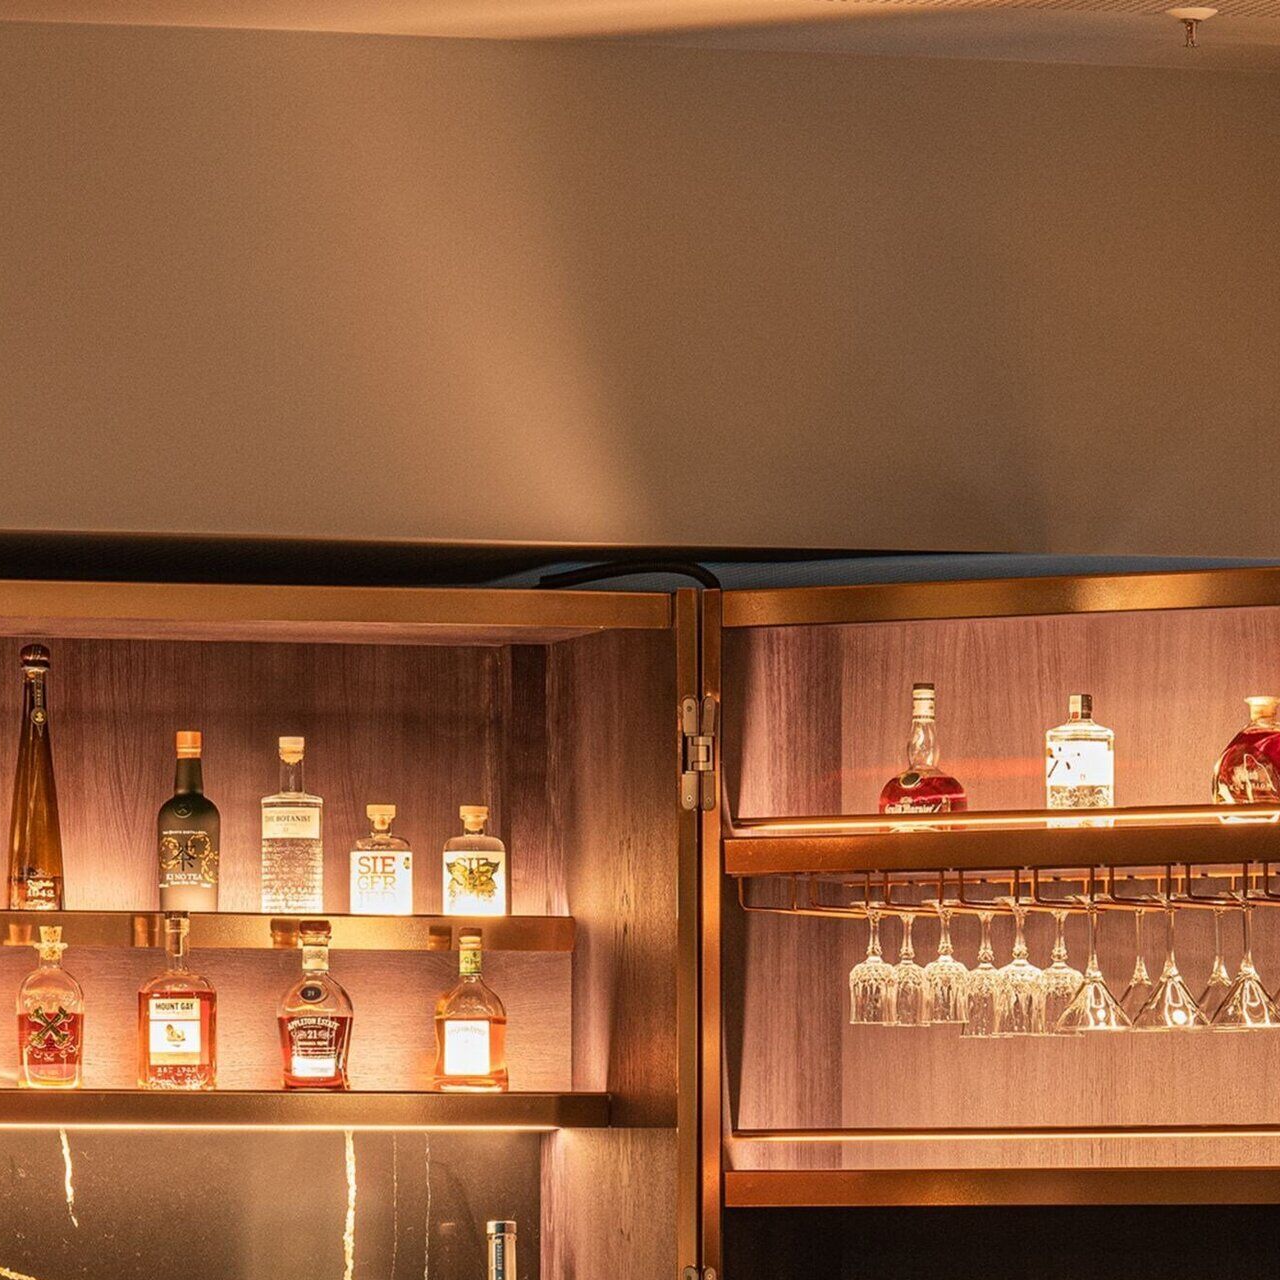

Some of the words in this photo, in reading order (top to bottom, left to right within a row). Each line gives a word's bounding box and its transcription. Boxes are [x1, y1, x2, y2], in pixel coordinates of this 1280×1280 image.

[358, 856, 396, 874] SIE
[455, 857, 489, 874] SIE
[155, 1002, 179, 1011] MOUNT
[180, 1002, 194, 1010] GAY
[307, 1030, 318, 1039] 21
